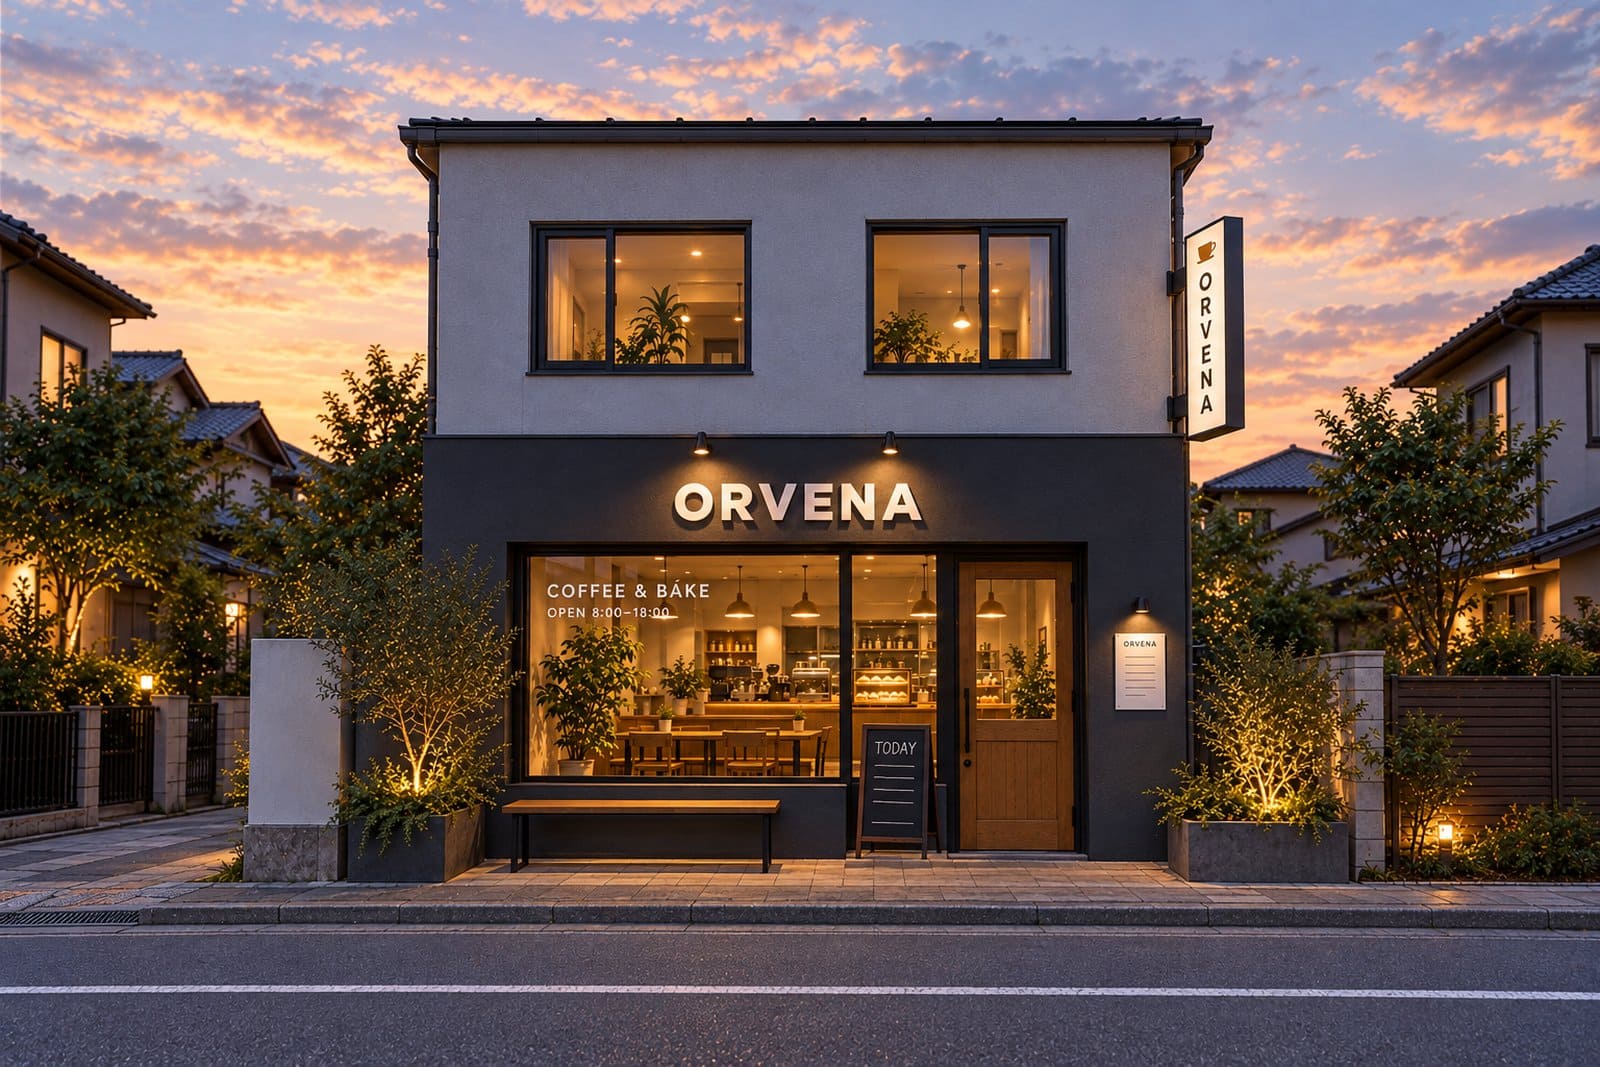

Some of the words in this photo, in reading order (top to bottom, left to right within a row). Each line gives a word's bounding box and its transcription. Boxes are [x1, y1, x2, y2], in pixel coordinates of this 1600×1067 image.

[1199, 272, 1213, 414] ORVENA
[674, 483, 922, 521] ORVENA
[547, 584, 625, 598] COFFEE
[635, 584, 647, 598] &
[547, 607, 585, 618] OPEN
[875, 741, 917, 755] TODAY
